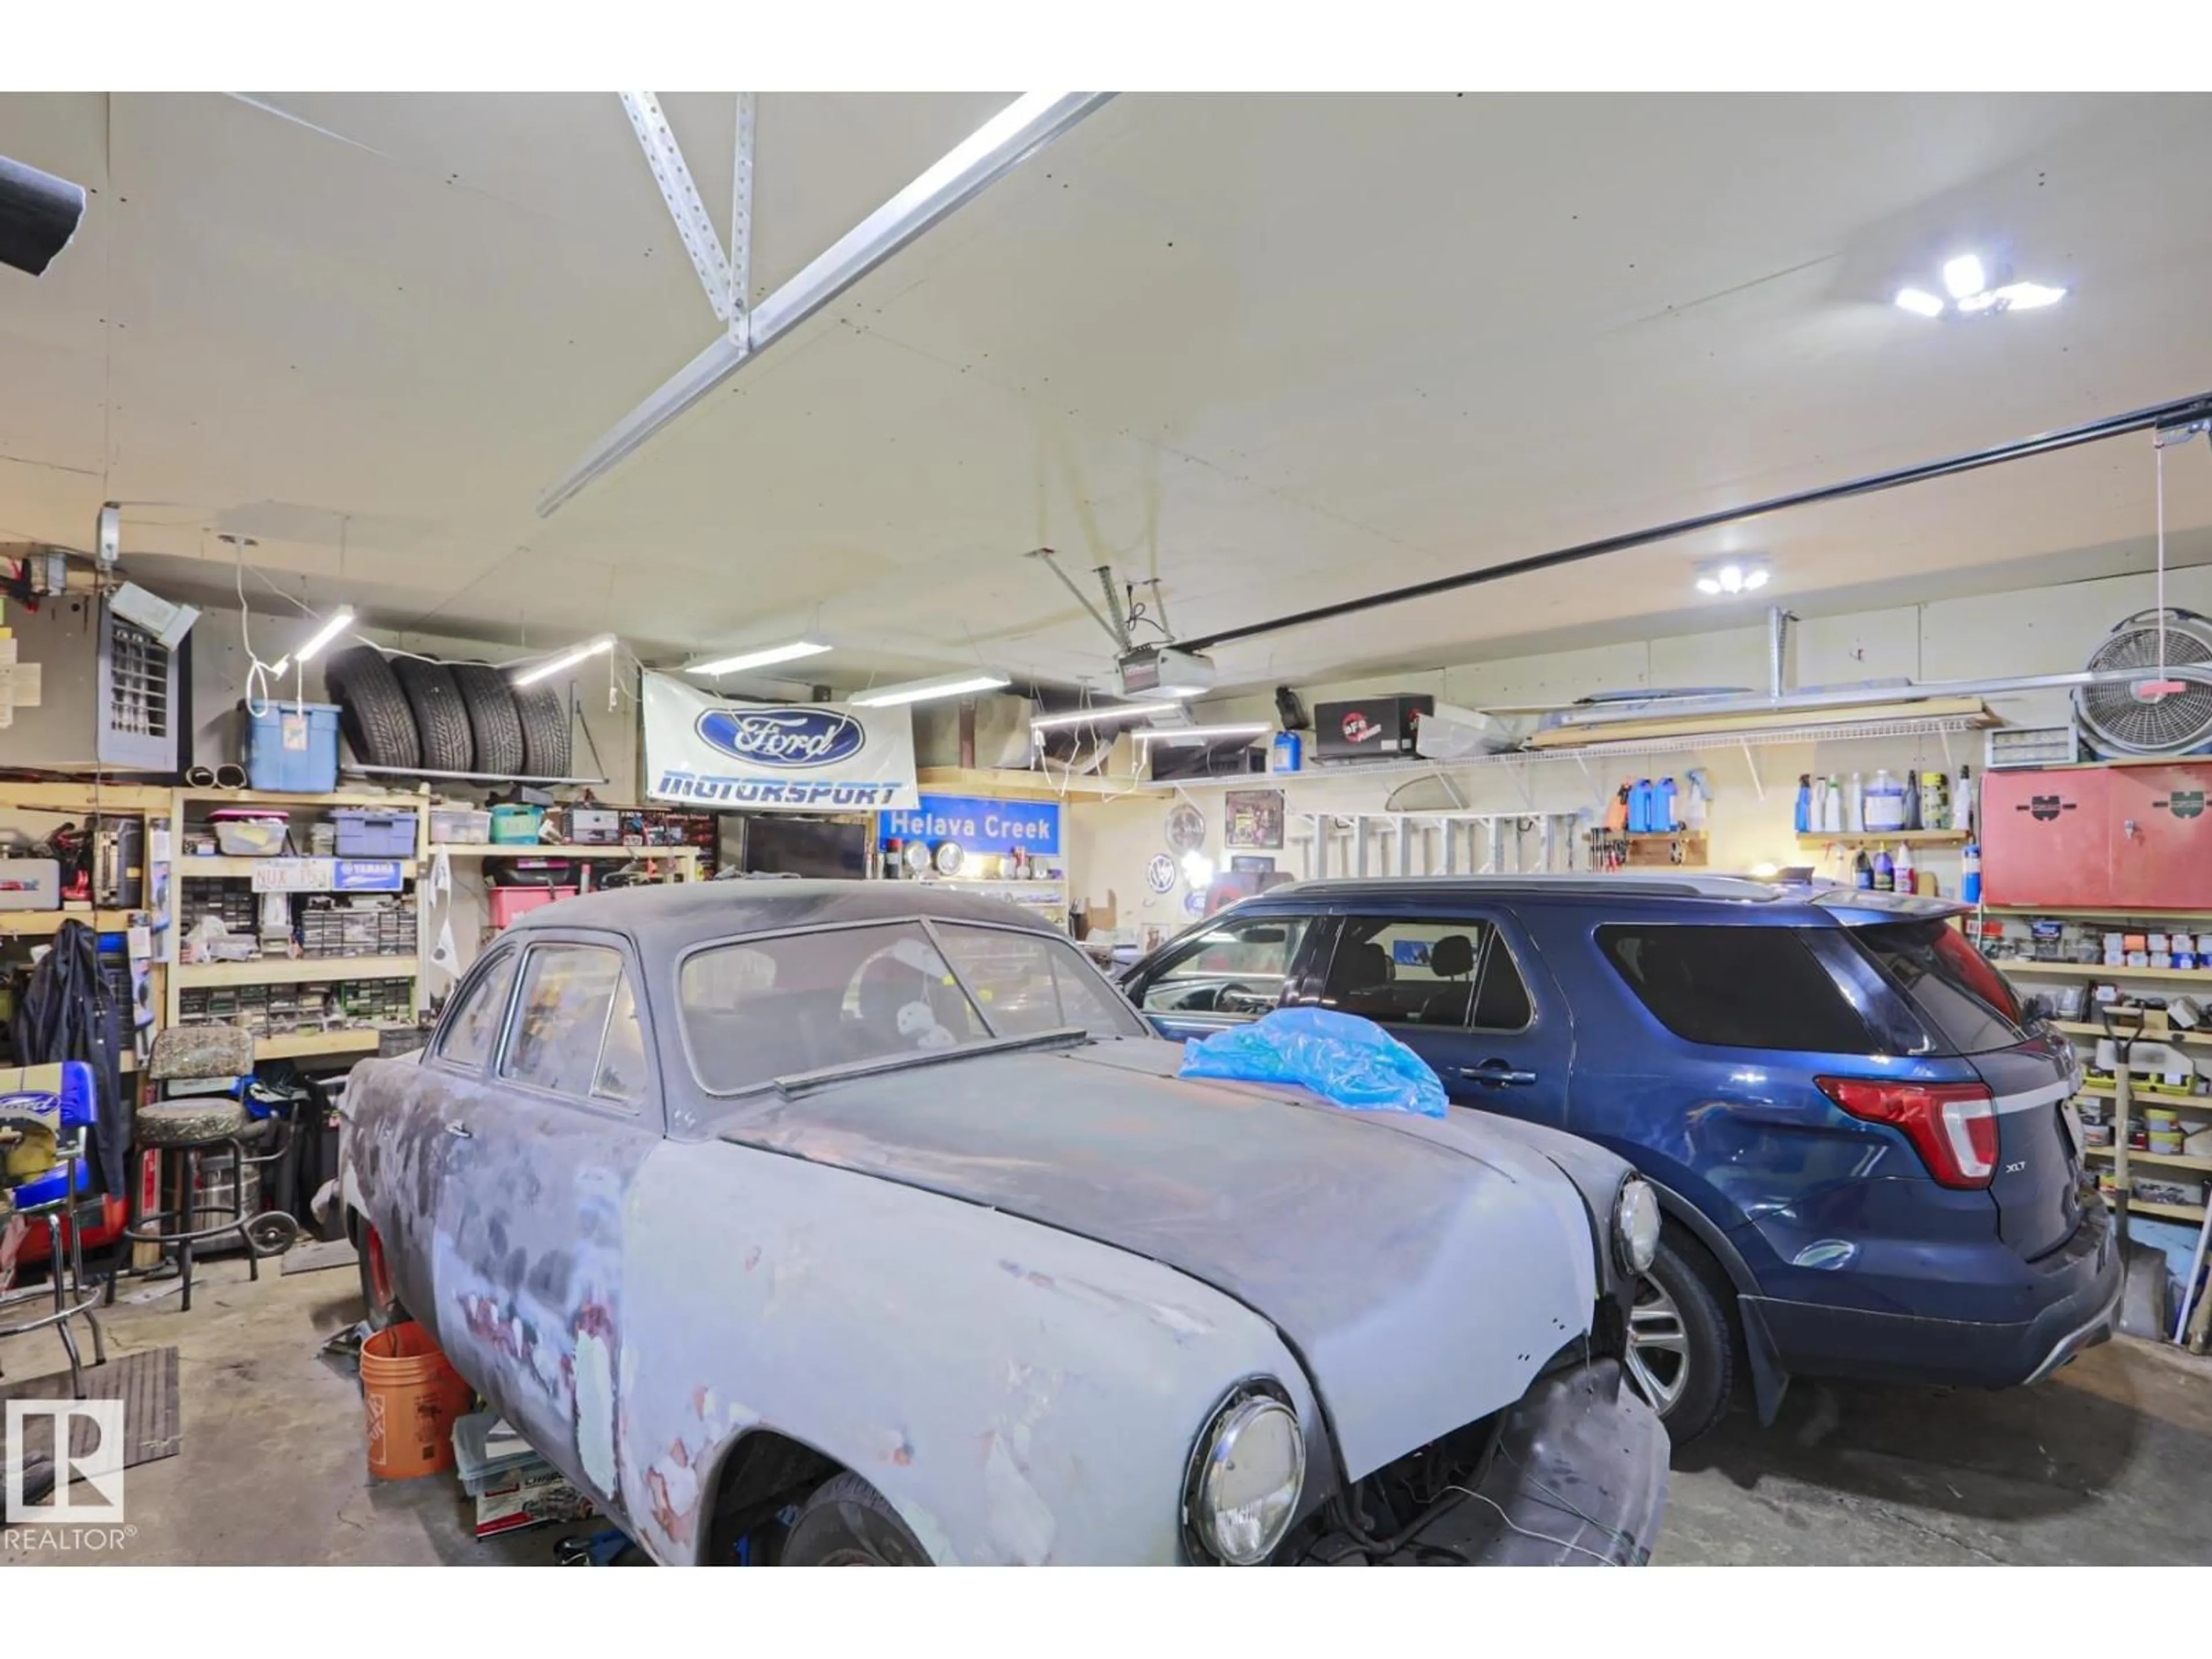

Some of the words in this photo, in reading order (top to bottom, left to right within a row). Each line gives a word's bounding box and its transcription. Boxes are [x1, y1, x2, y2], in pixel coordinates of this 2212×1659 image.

[734, 716, 839, 762] Ford
[890, 810, 975, 836] Helava
[984, 815, 1051, 839] Creek
[2005, 1161, 2026, 1173] XLT
